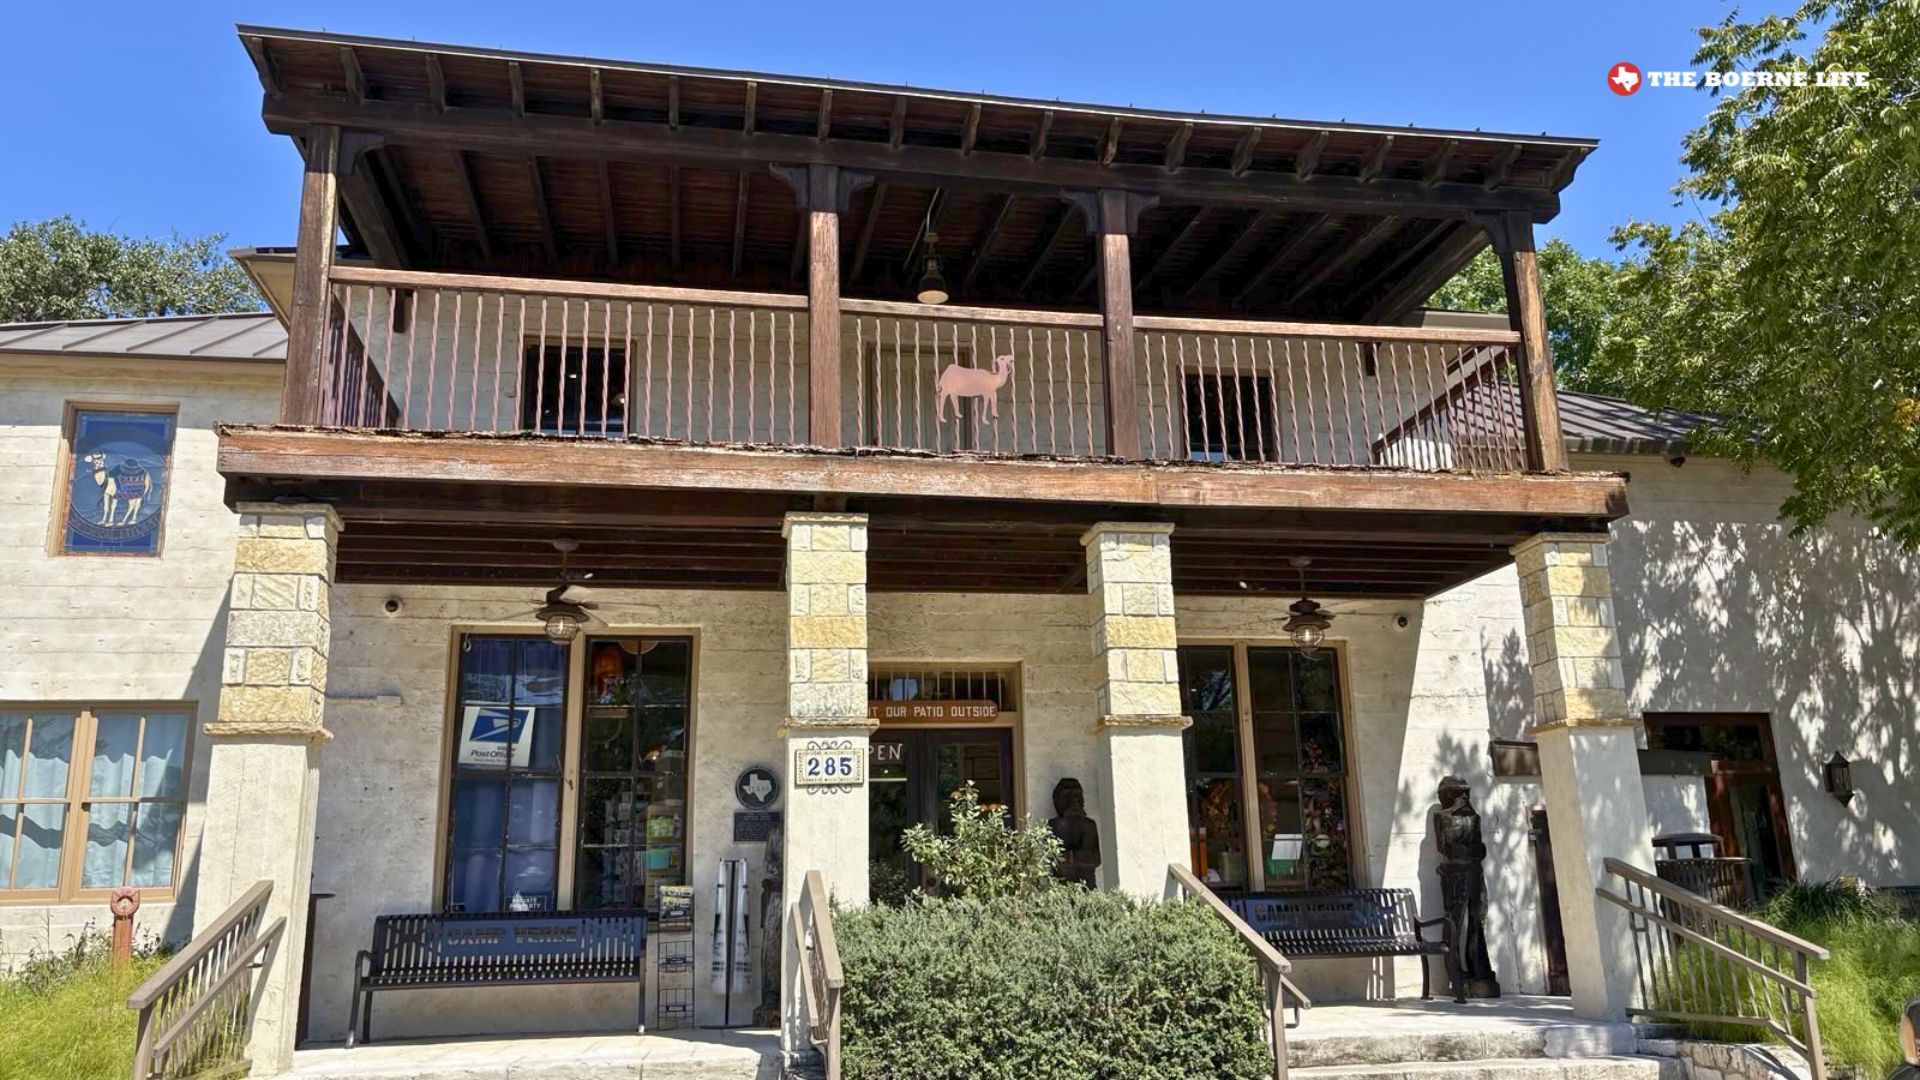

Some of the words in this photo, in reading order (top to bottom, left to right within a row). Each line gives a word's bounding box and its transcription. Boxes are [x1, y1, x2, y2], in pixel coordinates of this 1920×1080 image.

[886, 706, 907, 717] OUR
[914, 706, 943, 717] PATIO
[951, 706, 996, 717] OUTSIDE
[868, 743, 903, 760] PEN
[808, 757, 852, 776] 285
[447, 928, 499, 945] CAMP
[513, 926, 577, 943] VERDE
